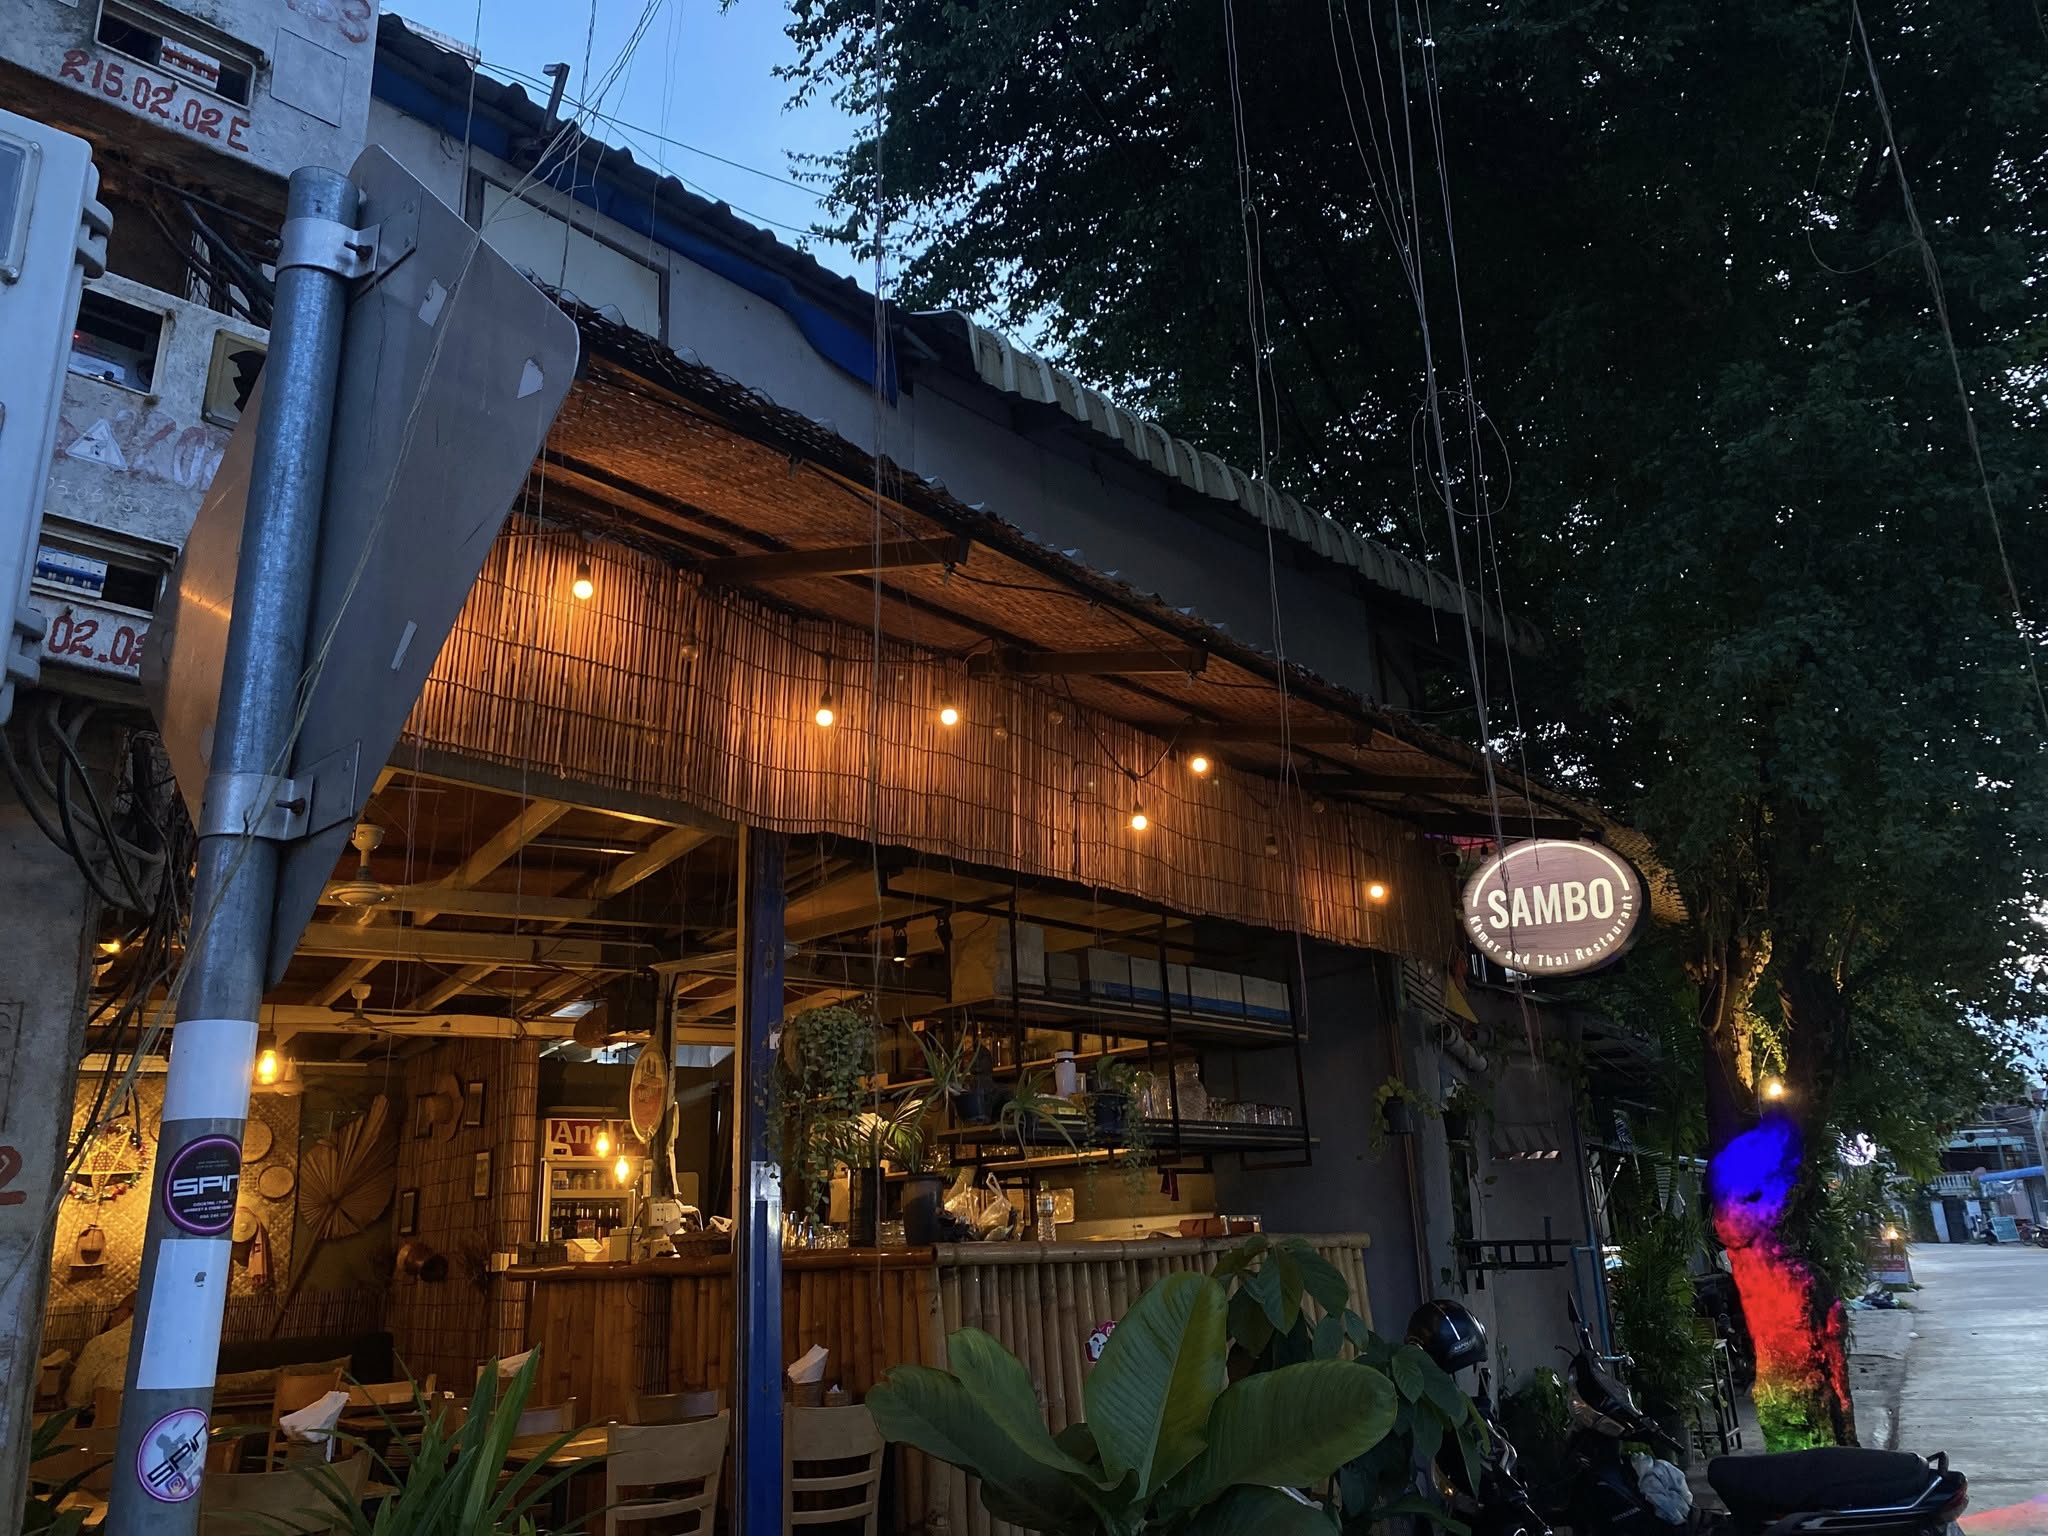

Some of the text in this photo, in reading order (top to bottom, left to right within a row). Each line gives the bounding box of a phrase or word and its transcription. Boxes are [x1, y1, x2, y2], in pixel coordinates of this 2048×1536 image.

[1469, 894, 1634, 967] Khmer and Thai Restaurant
[1487, 877, 1615, 930] SAMBO
